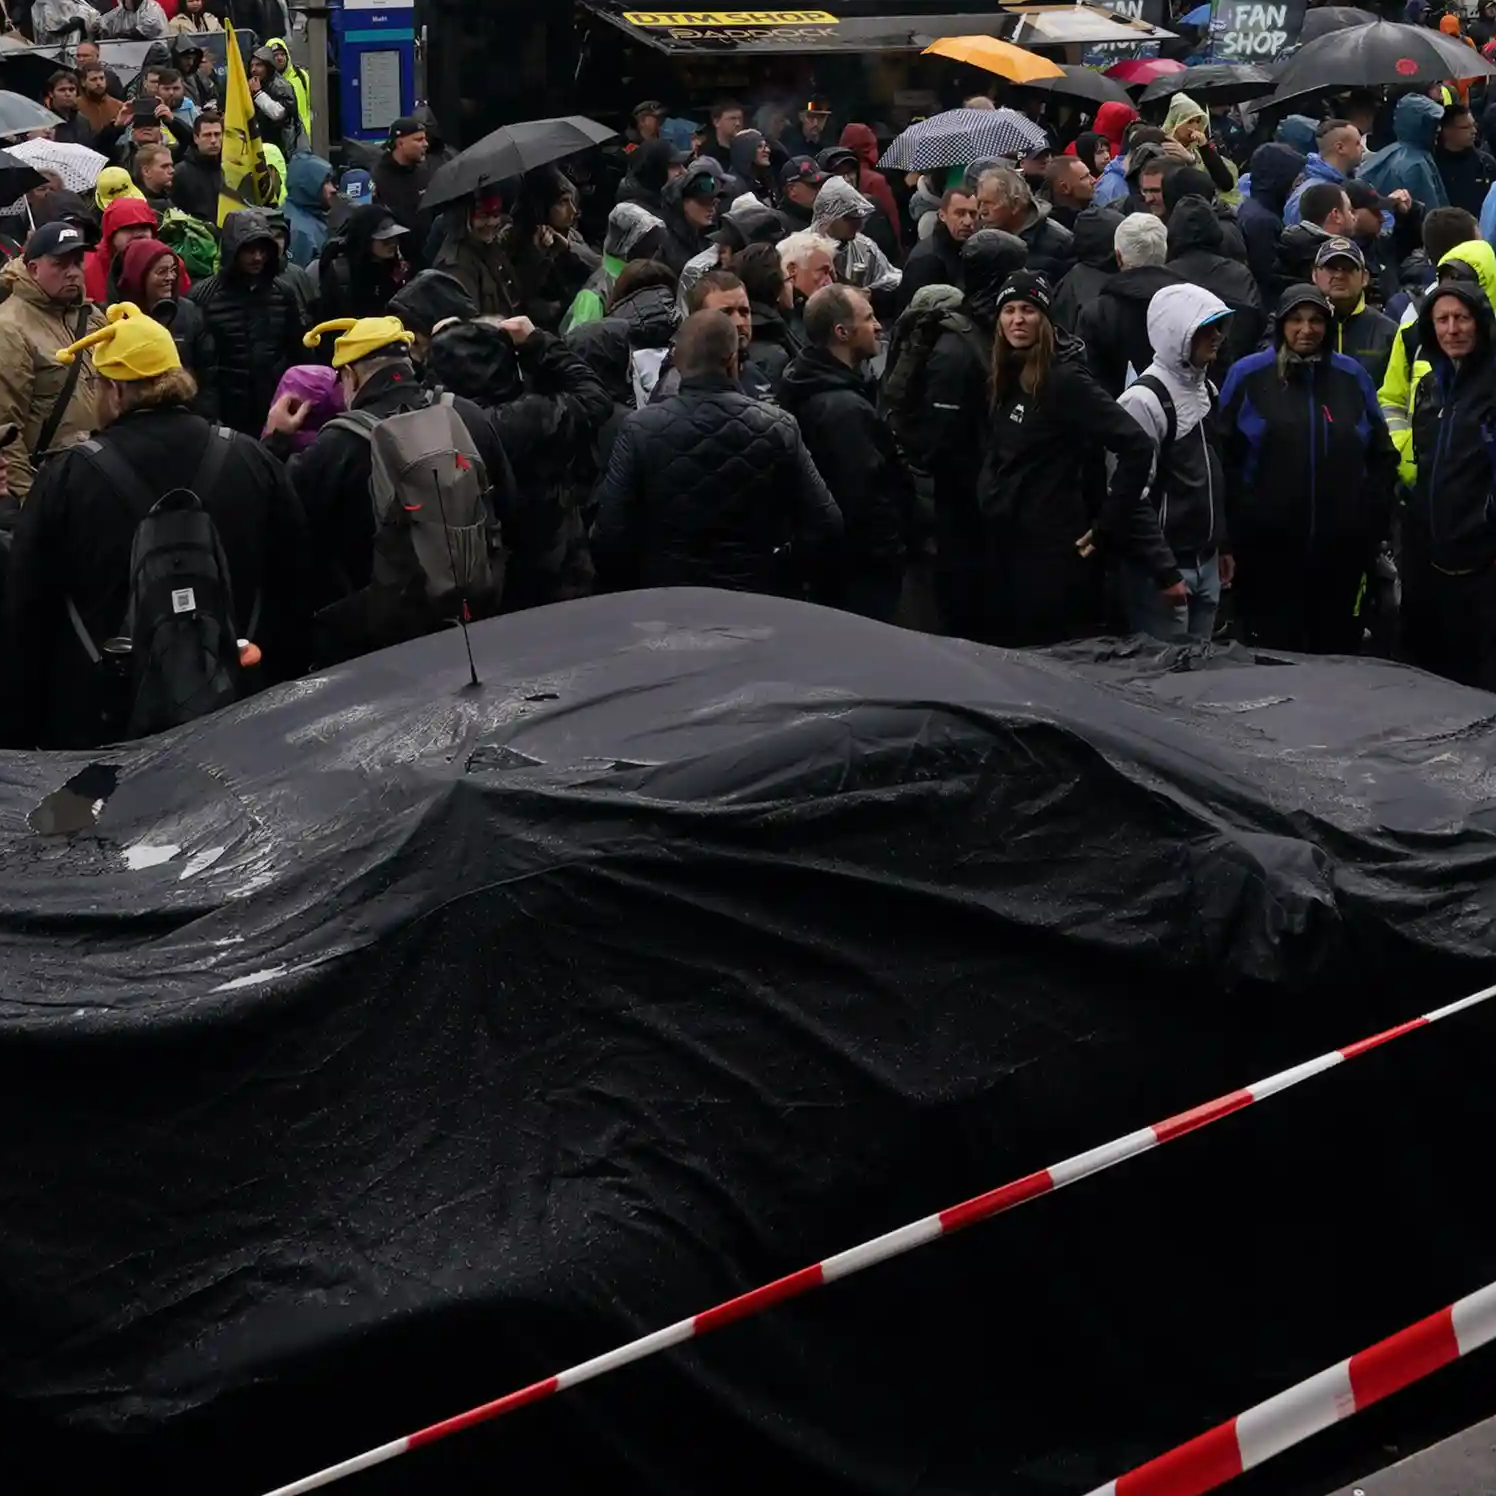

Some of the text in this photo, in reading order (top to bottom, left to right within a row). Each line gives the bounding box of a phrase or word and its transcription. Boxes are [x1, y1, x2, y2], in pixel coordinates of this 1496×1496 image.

[630, 12, 822, 24] DTM SHOP
[1234, 3, 1288, 30] FAN
[668, 27, 840, 41] PADDOCK
[1223, 30, 1288, 55] SHOP
